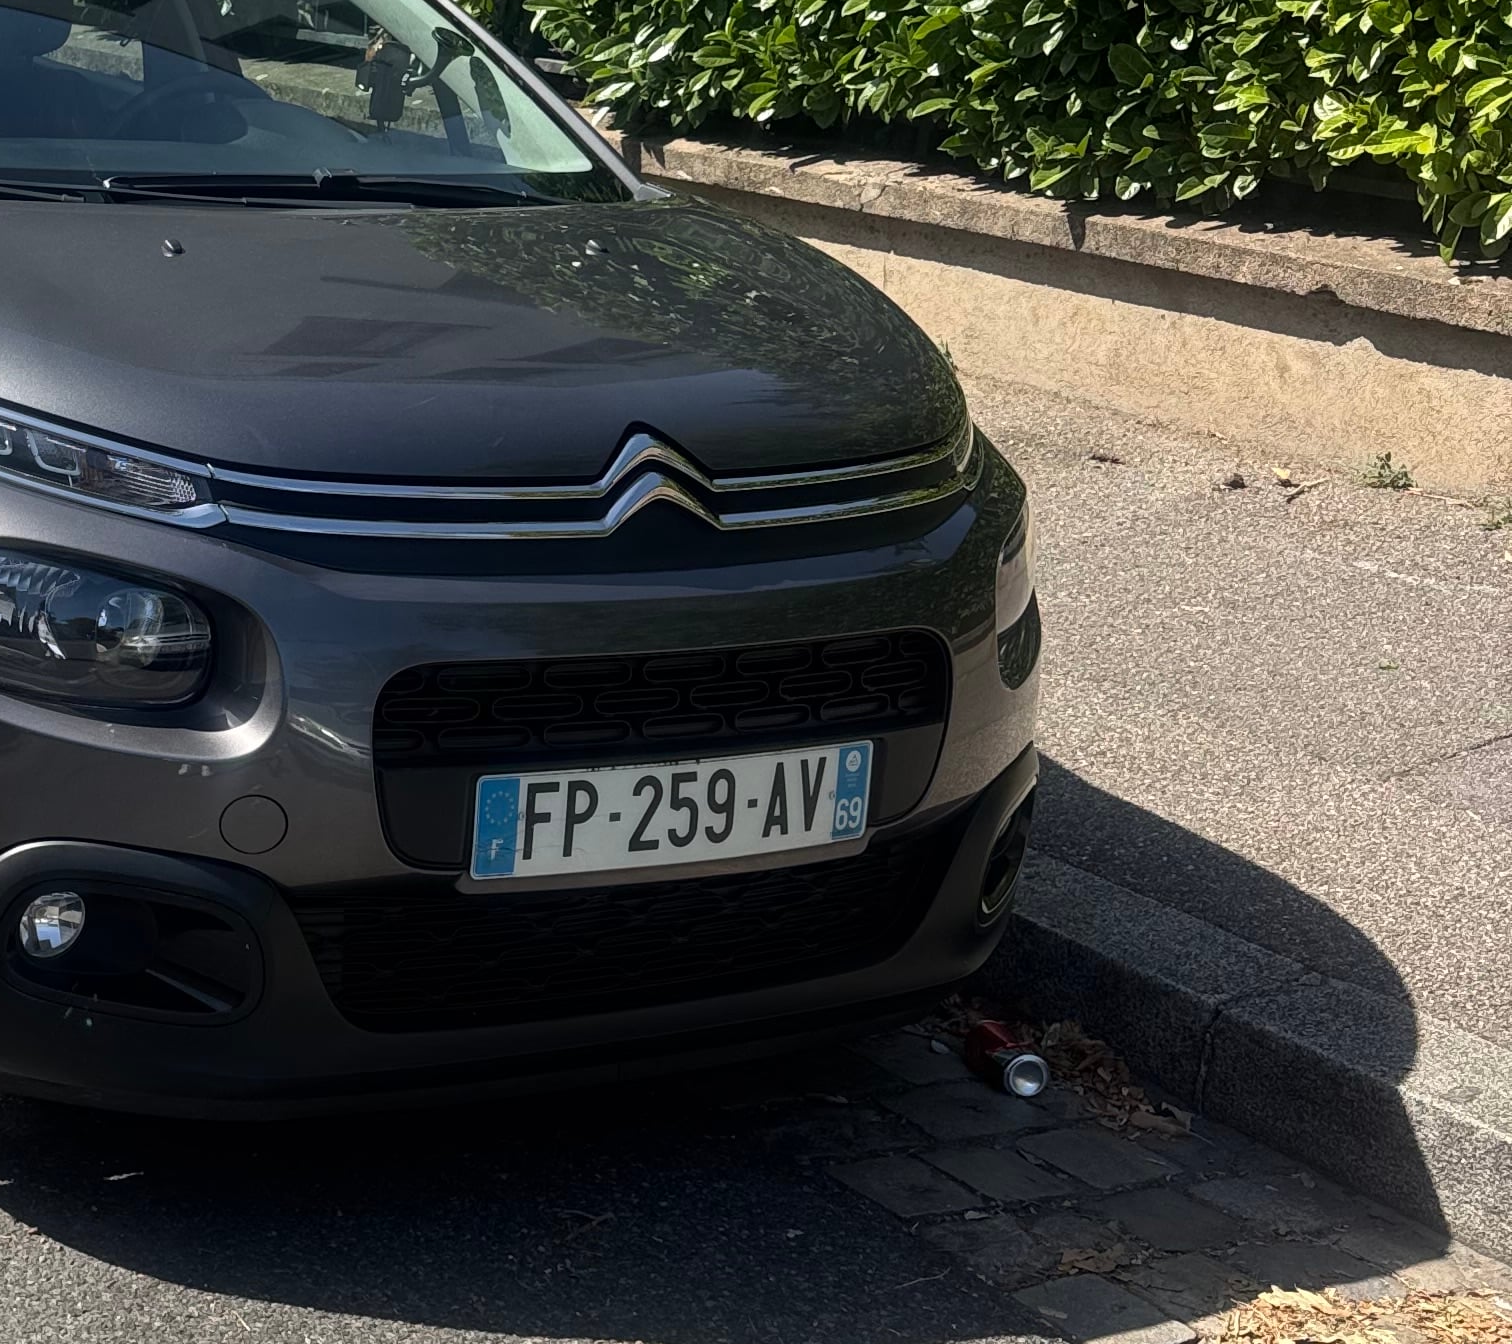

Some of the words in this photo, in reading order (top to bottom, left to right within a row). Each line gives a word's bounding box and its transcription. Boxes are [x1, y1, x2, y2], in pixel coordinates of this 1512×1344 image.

[522, 756, 827, 861] FP-259-AV
[835, 796, 863, 831] 69
[490, 839, 504, 861] F
